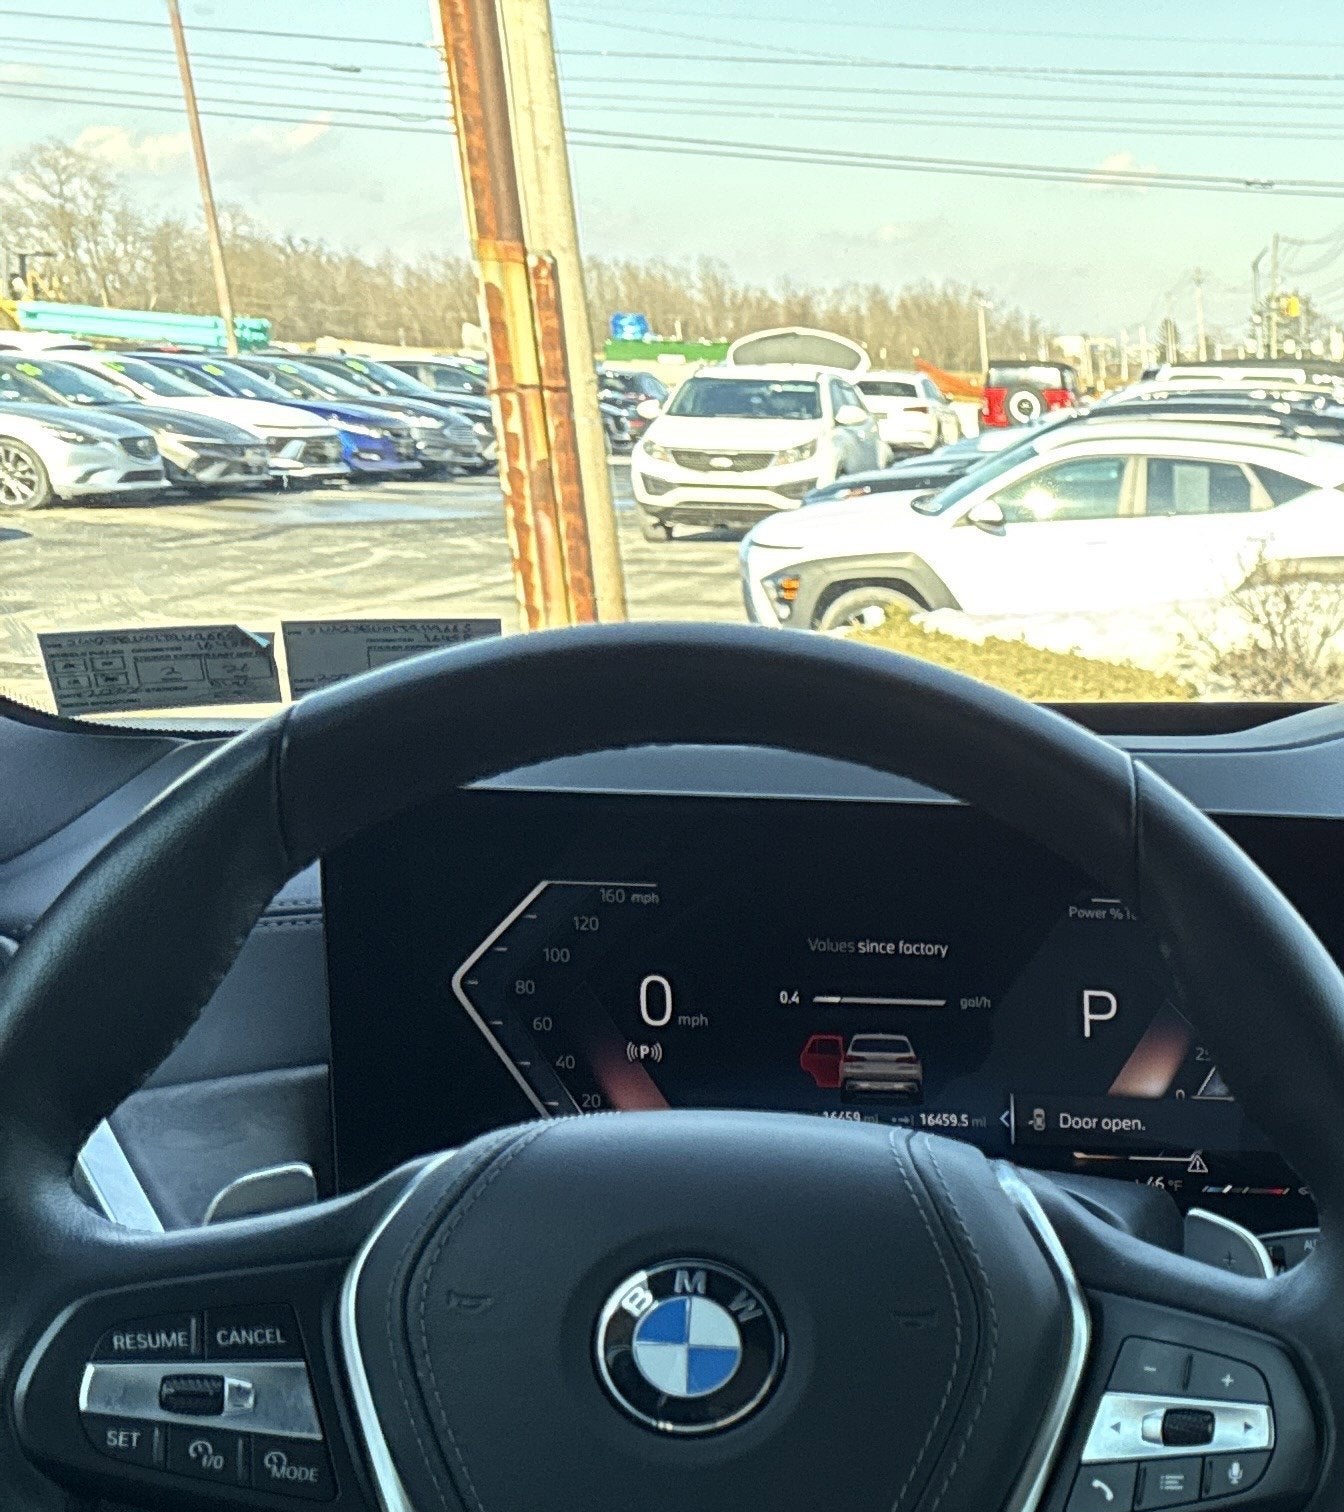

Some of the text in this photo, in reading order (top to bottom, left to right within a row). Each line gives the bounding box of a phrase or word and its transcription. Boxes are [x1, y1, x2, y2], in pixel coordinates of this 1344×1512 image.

[601, 889, 659, 905] 160 mph
[1069, 906, 1107, 919] Power
[574, 917, 599, 931] 120
[544, 949, 570, 963] 100
[808, 938, 949, 959] Values since factory
[515, 980, 535, 995] 80
[640, 975, 709, 1028] 0 mph
[779, 991, 800, 1004] 0.4
[960, 997, 991, 1009] gal/h
[1083, 990, 1118, 1037] P
[533, 1017, 552, 1031] 60
[556, 1055, 575, 1070] 40
[583, 1094, 601, 1108] 20
[919, 1113, 969, 1127] 16459.5
[1059, 1113, 1146, 1132] Door open.
[621, 1270, 763, 1323] BMW
[112, 1331, 189, 1350] RESUME
[216, 1328, 286, 1346] CANCEL
[106, 1429, 141, 1449] SET
[272, 1466, 319, 1483] MODE
